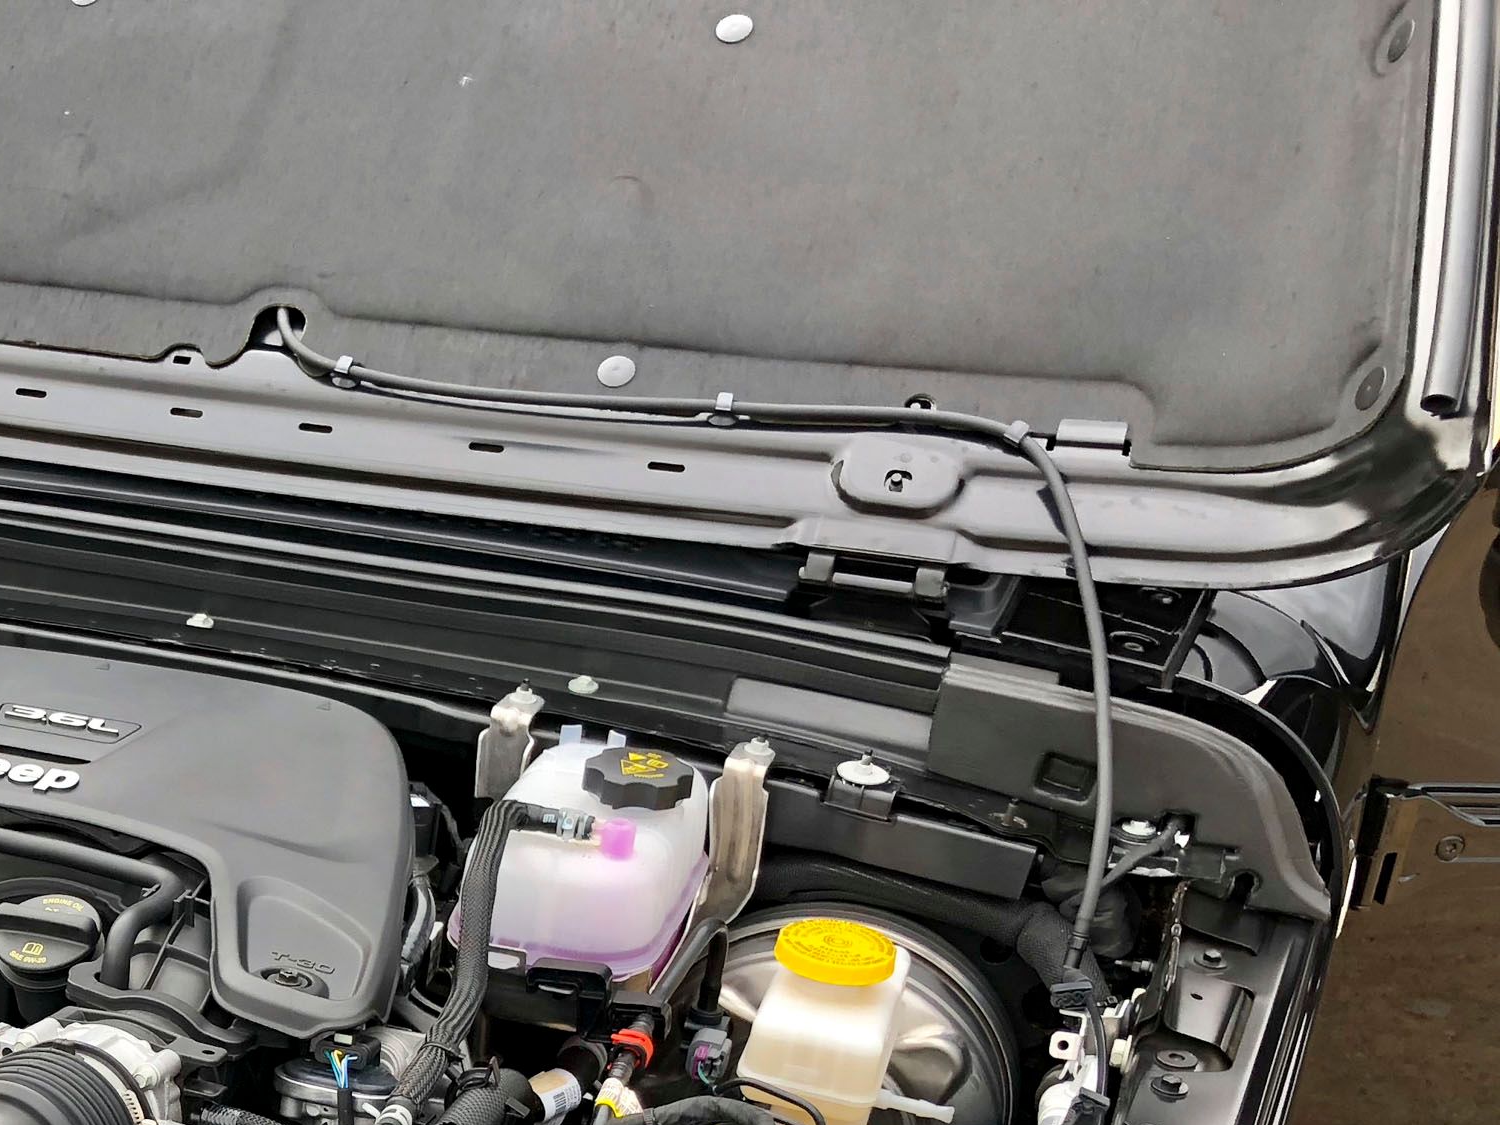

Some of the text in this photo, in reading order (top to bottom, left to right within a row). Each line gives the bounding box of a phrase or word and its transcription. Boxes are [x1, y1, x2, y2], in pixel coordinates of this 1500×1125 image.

[4, 704, 119, 736] 3.6L
[42, 897, 74, 908] ENGINE
[271, 951, 336, 974] T-30
